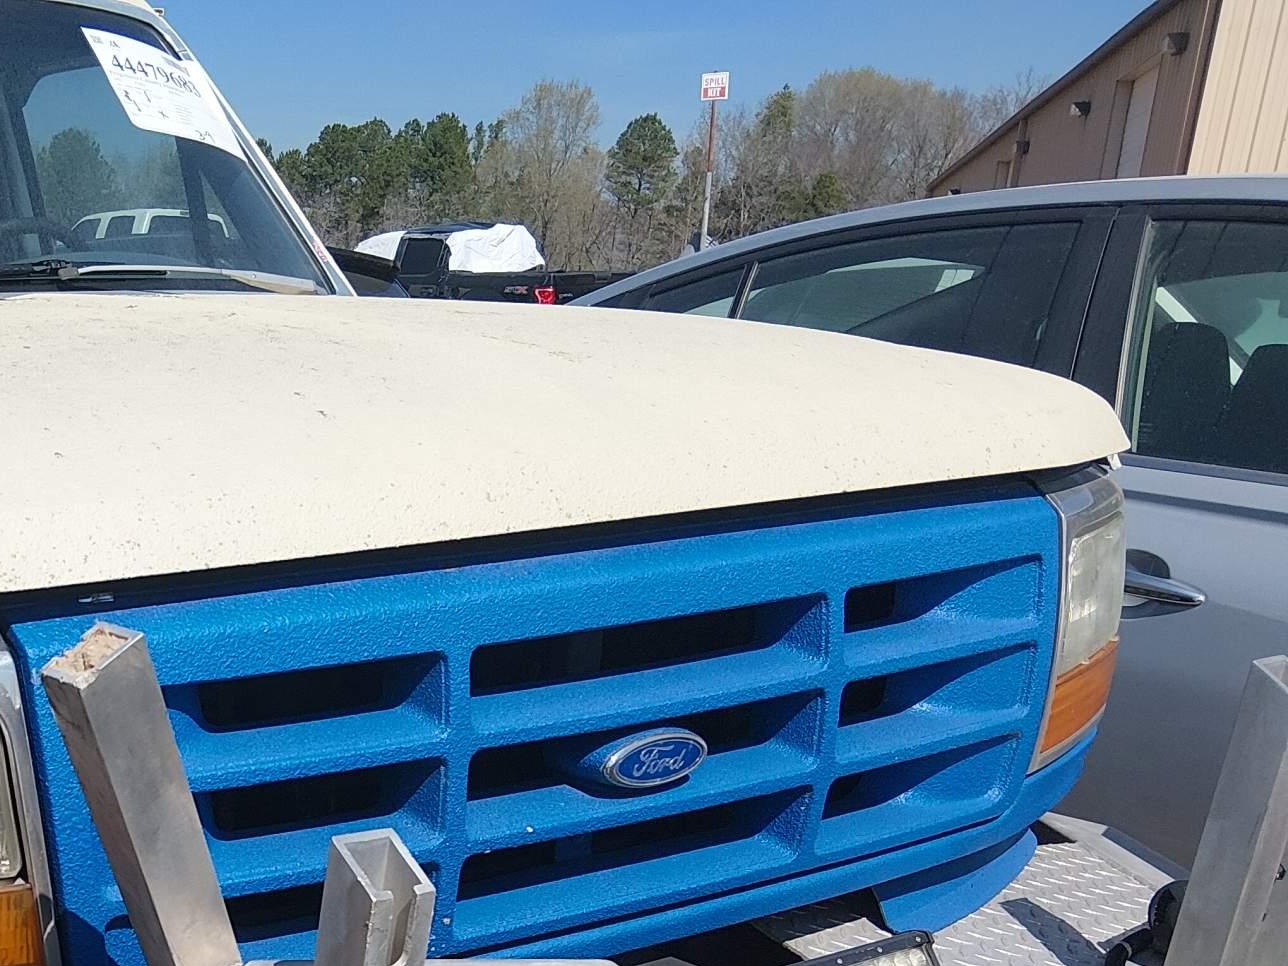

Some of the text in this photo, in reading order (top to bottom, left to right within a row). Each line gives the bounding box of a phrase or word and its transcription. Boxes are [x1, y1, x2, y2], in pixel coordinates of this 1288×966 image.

[111, 54, 201, 98] 44479683
[704, 76, 724, 87] SPILL
[632, 744, 687, 777] Ford
